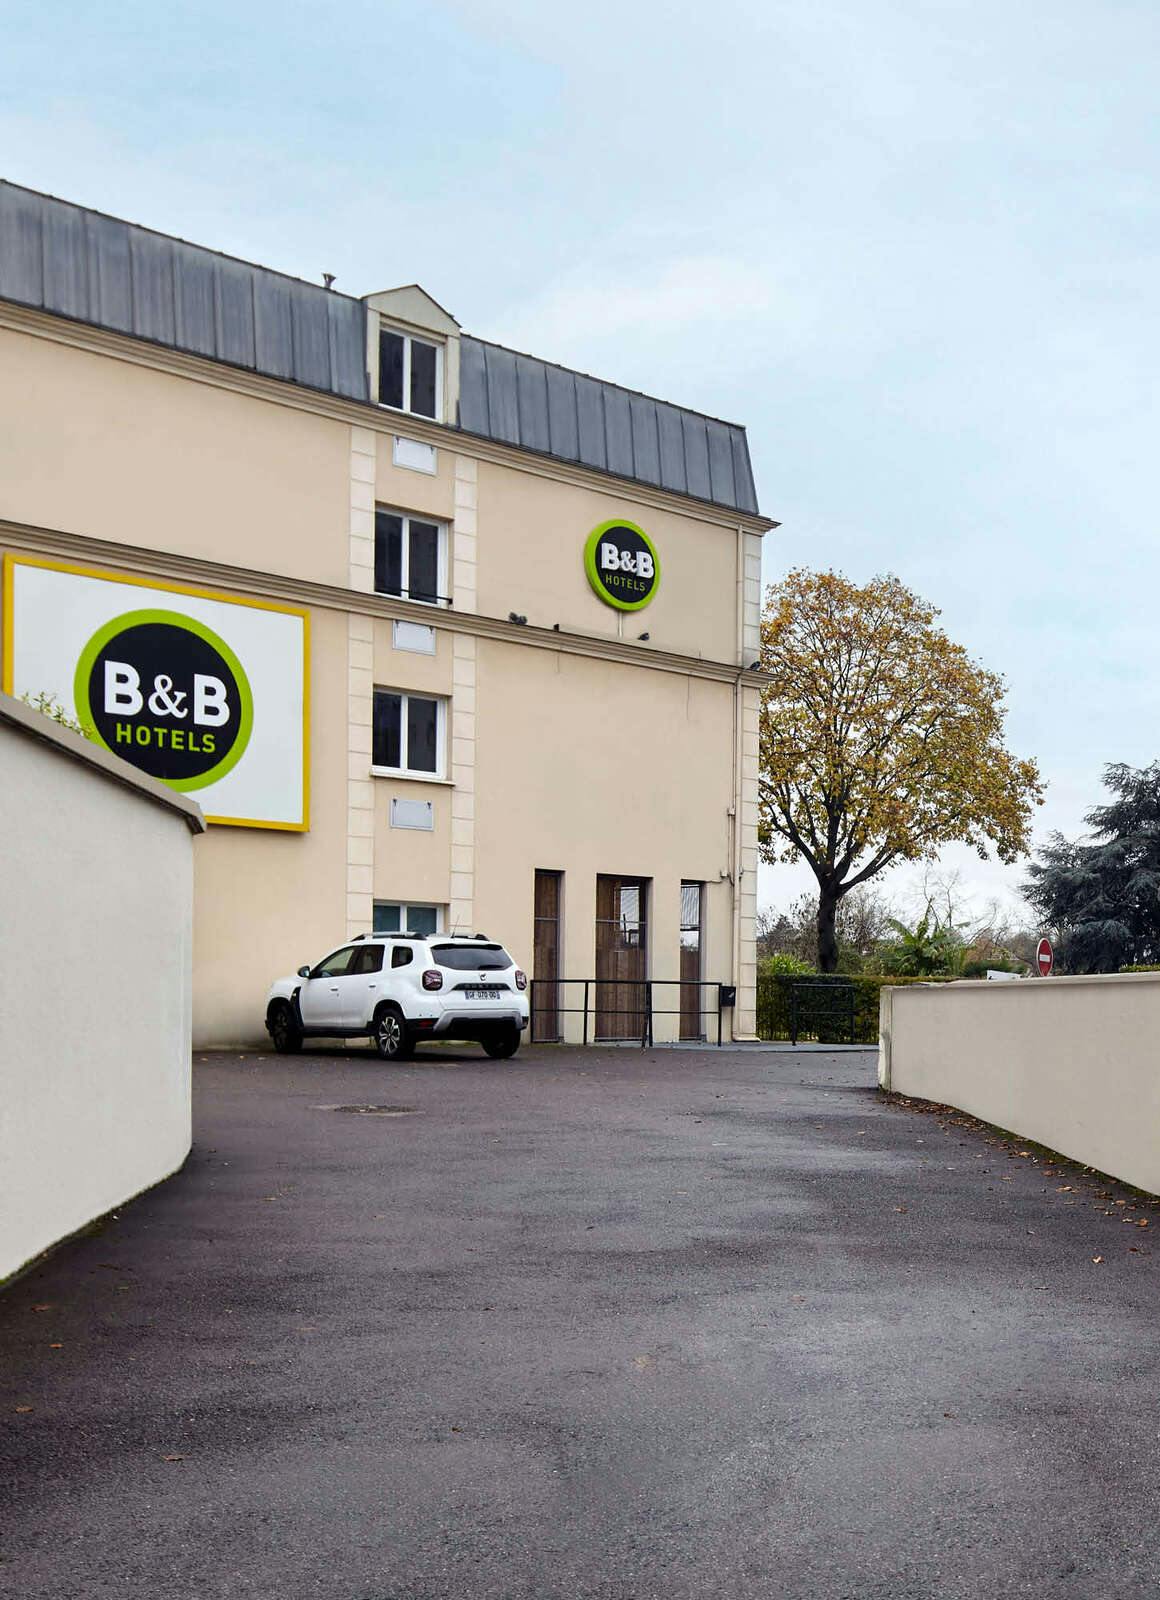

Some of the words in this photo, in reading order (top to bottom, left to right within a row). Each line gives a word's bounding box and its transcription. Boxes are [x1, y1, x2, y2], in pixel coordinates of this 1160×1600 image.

[601, 542, 654, 578] B&B
[605, 574, 646, 591] HOTELS
[104, 660, 230, 727] B&B
[116, 723, 216, 753] HOTELS
